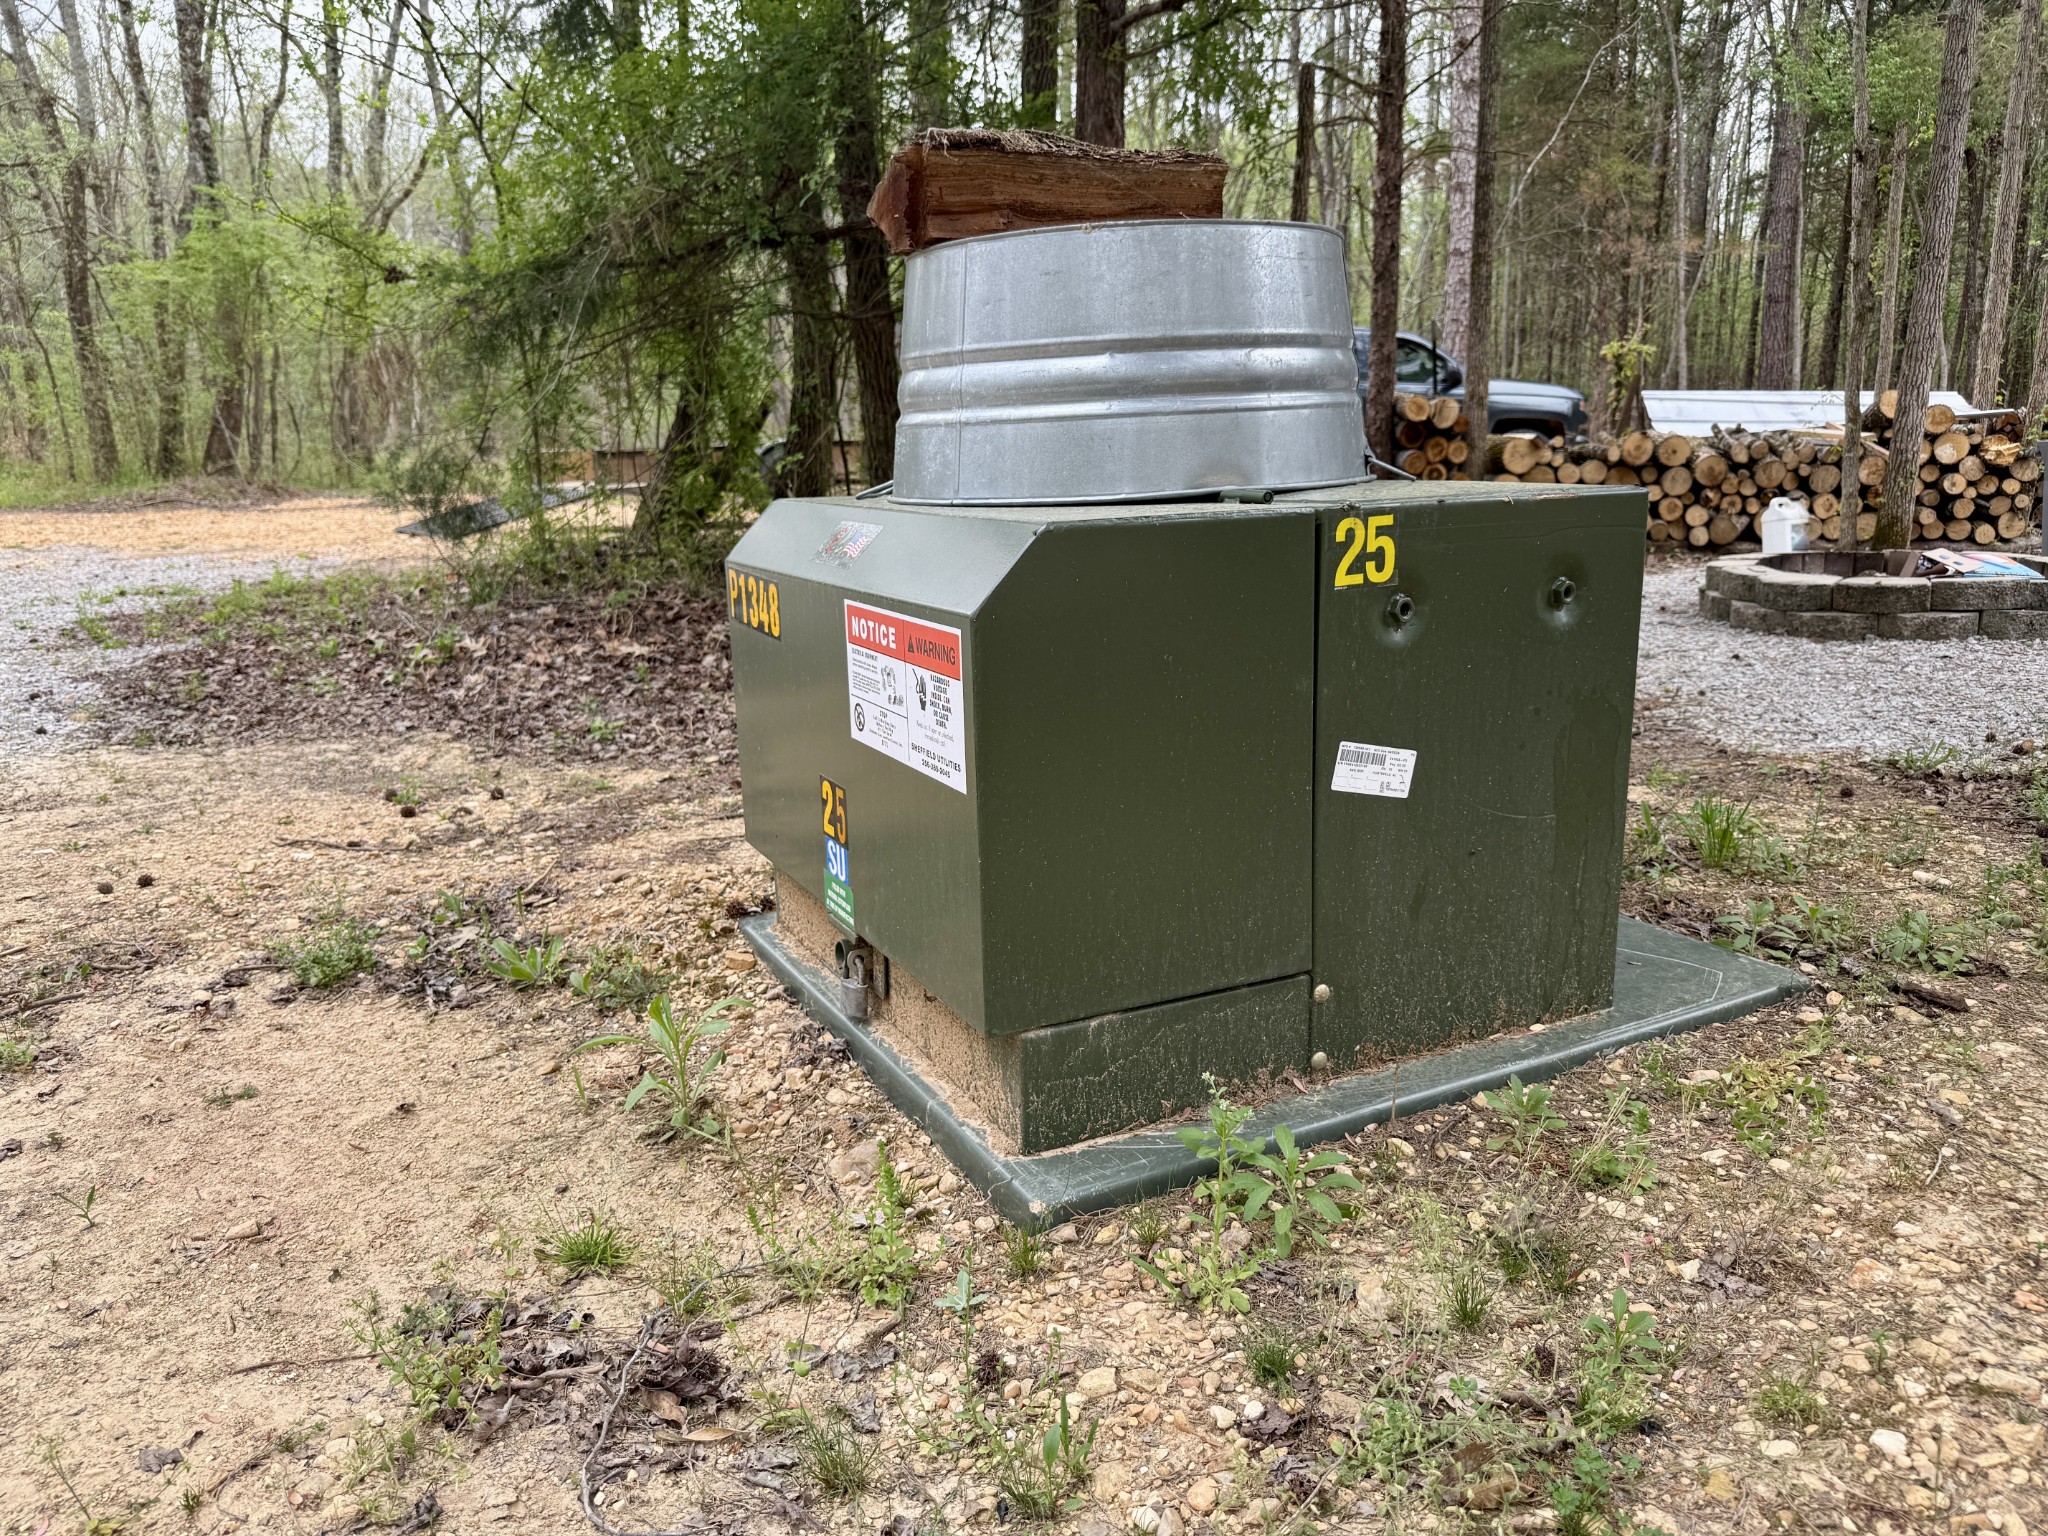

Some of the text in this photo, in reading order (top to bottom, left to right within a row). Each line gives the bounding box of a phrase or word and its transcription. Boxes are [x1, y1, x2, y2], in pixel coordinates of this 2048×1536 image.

[1335, 514, 1396, 587] 25
[728, 568, 781, 638] P1348
[851, 615, 897, 650] NOTICE
[915, 636, 956, 667] WARNING
[911, 742, 962, 773] SHEFFIELD UTILITIES
[822, 780, 846, 844] 25
[827, 839, 846, 882] SU
